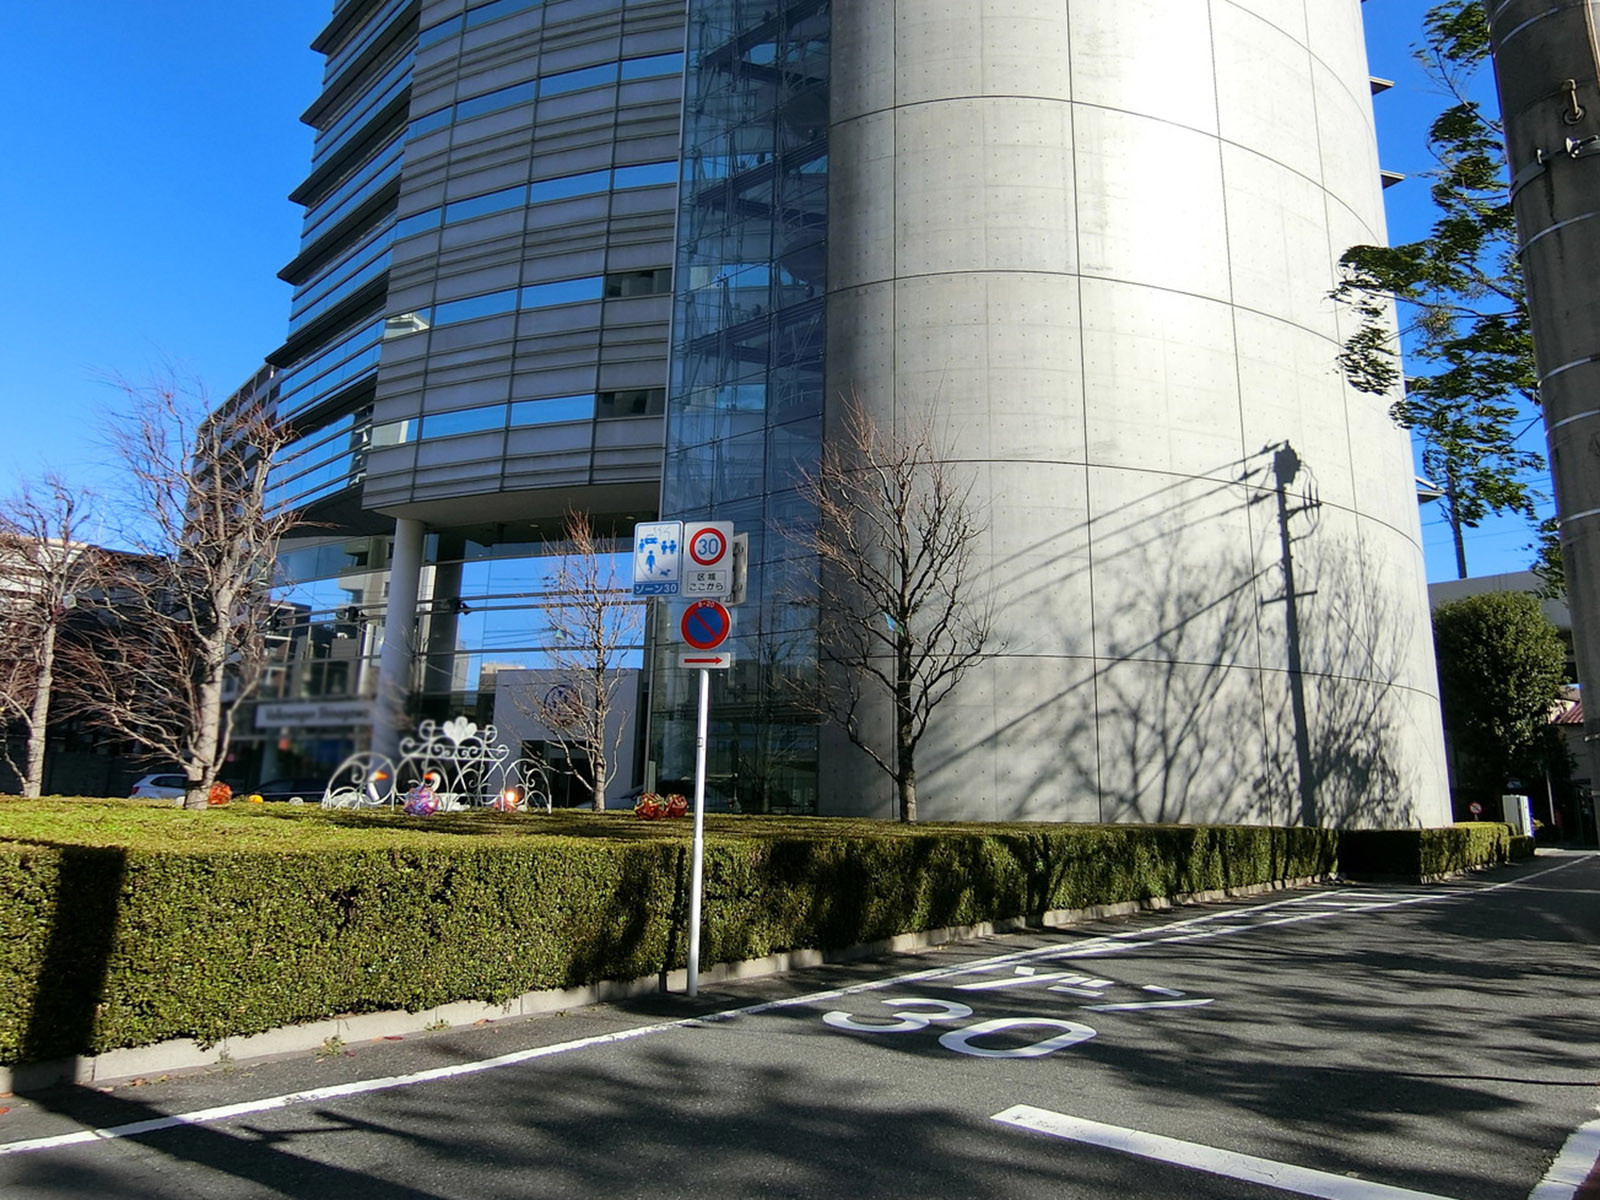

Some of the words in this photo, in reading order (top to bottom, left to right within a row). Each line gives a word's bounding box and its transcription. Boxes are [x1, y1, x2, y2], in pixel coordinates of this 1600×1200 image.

[698, 538, 719, 556] 30
[697, 573, 716, 581] 区域
[689, 583, 723, 591] ここから
[822, 998, 1097, 1058] 30
